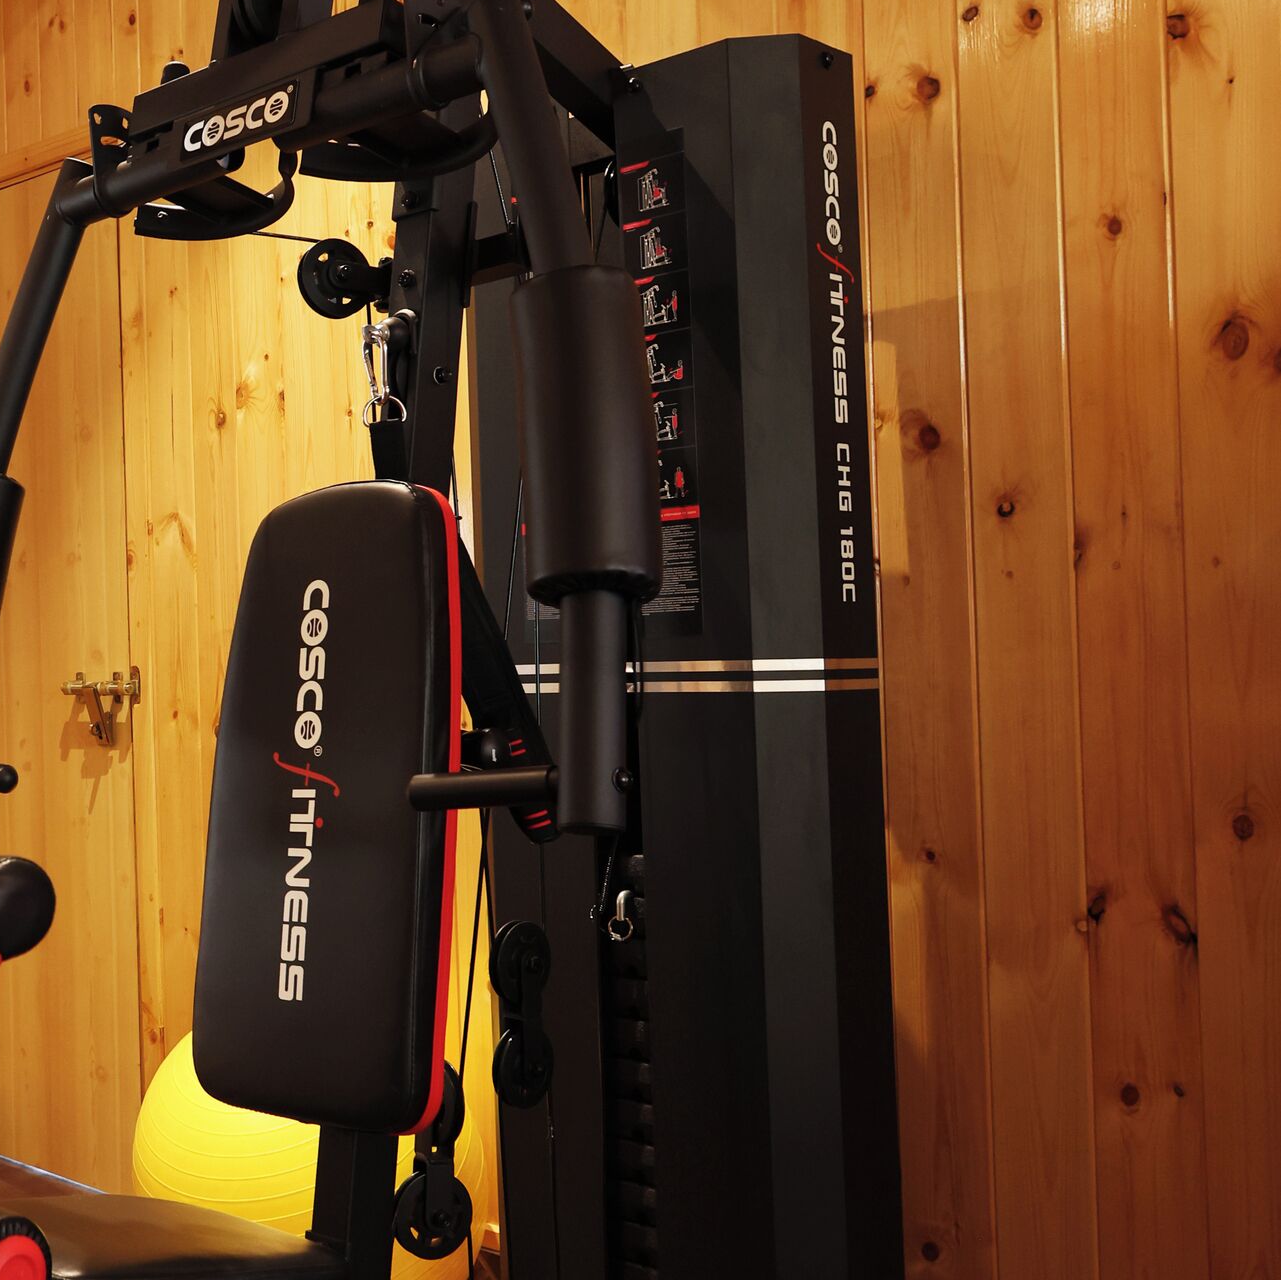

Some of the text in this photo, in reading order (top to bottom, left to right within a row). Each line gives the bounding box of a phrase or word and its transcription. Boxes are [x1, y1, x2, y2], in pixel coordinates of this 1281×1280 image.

[183, 91, 289, 152] COSCO
[822, 121, 842, 247] COSCO
[836, 442, 852, 512] CHG
[840, 526, 856, 602] 180C
[294, 579, 330, 749] COSCO
